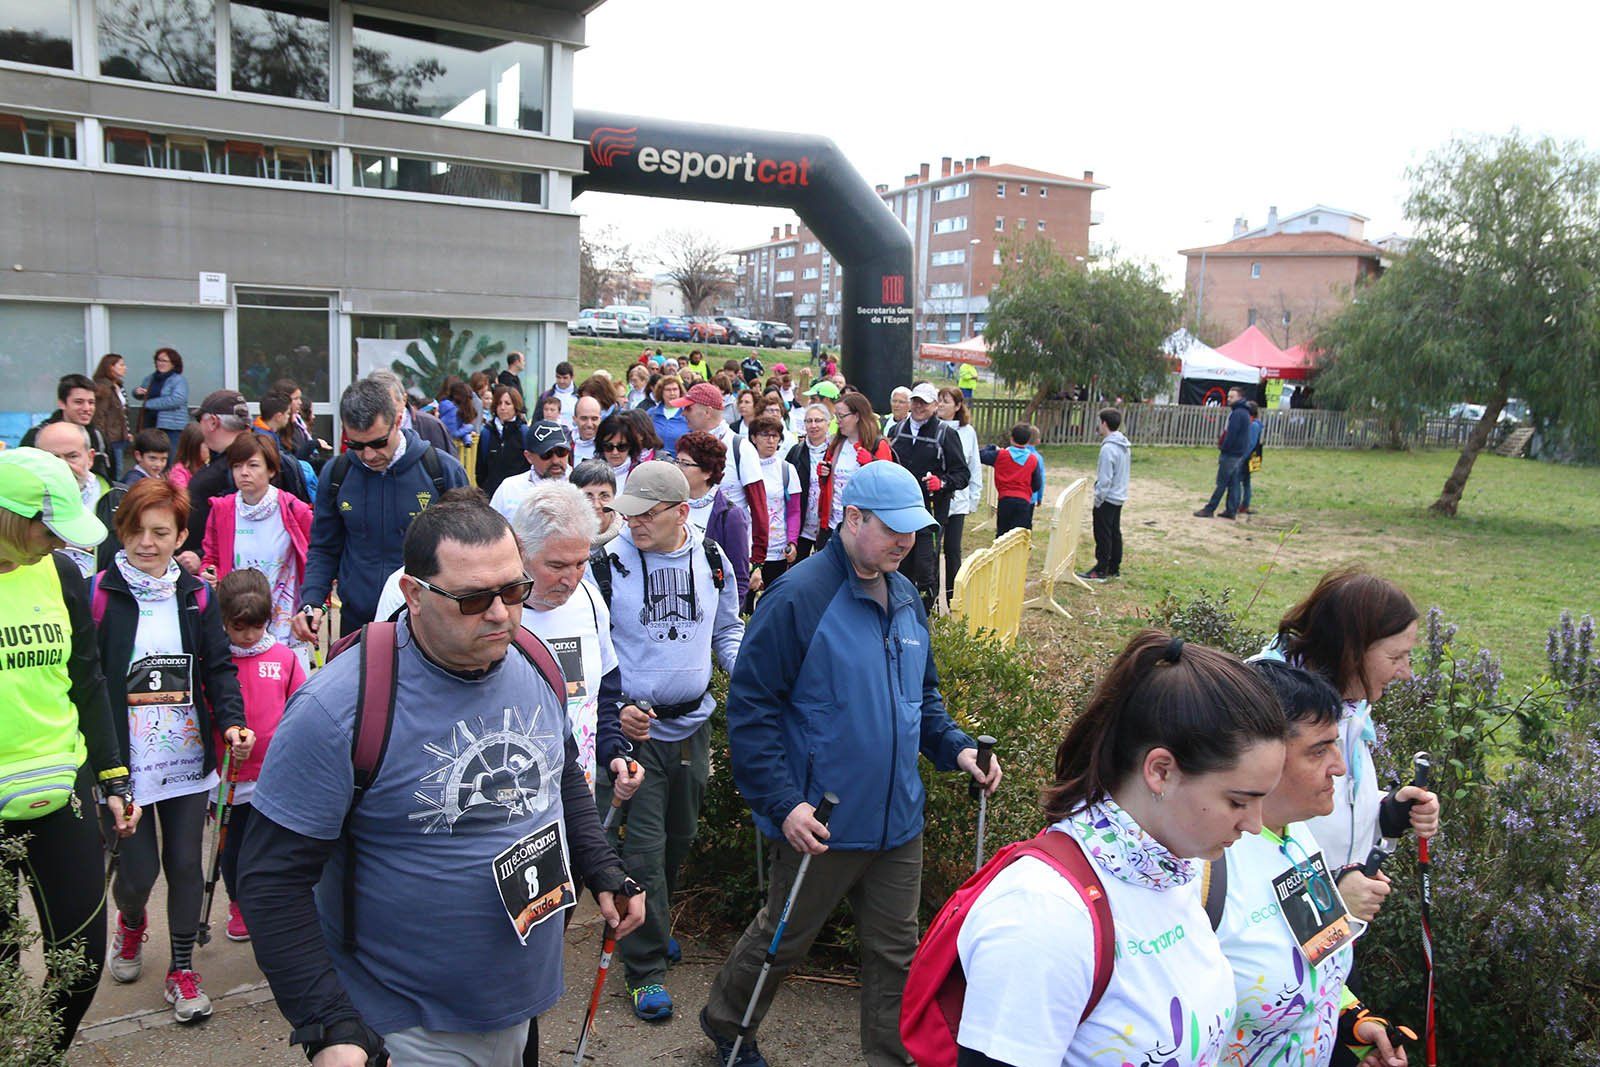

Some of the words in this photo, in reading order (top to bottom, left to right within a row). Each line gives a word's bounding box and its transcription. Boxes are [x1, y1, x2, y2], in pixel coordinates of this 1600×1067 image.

[638, 146, 809, 187] esportcat
[857, 306, 895, 315] Secretaria
[871, 316, 881, 324] de
[6, 649, 63, 670] NORDICA
[149, 670, 162, 691] 3
[259, 666, 281, 680] SIX
[499, 858, 515, 880] III
[511, 830, 556, 866] ecomarxa
[524, 865, 540, 899] 8
[1300, 892, 1323, 927] 1
